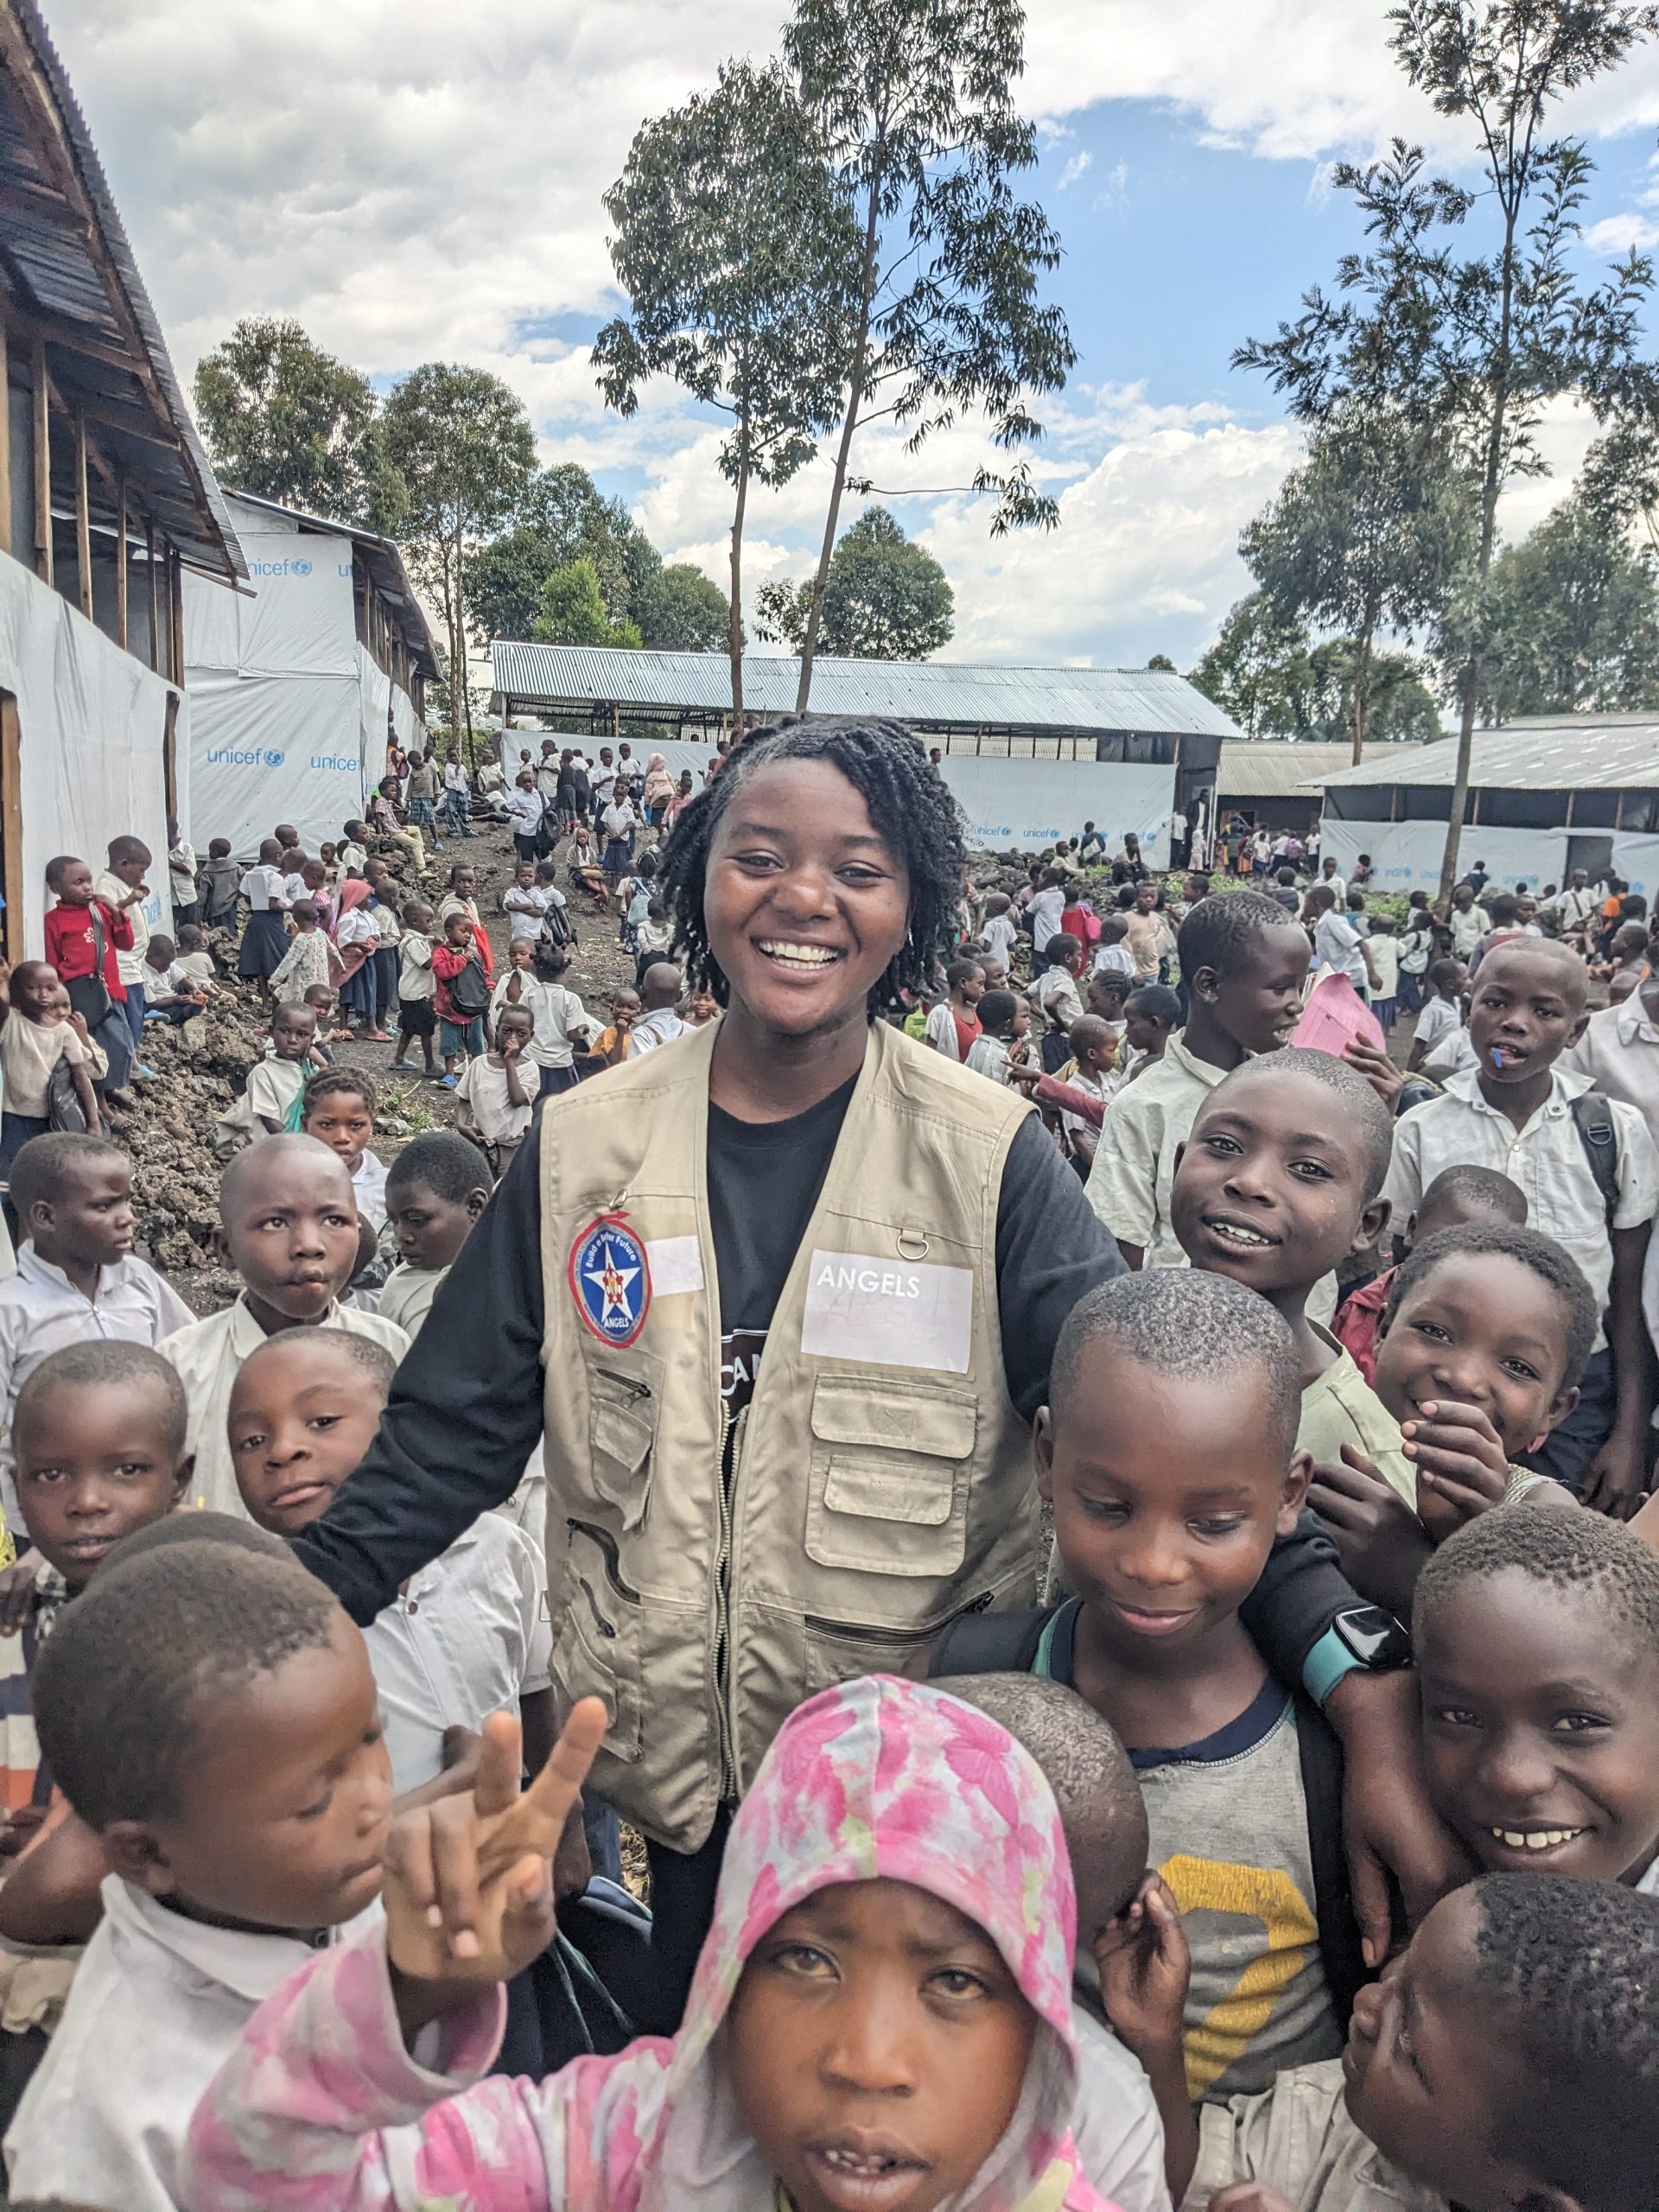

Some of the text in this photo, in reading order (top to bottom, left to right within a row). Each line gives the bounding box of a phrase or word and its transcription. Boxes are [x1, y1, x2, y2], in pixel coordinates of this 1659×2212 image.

[248, 559, 289, 576] nicef
[207, 747, 263, 765] unicef
[974, 827, 1050, 838] unicef unicef
[585, 1245, 598, 1268] Build
[615, 1236, 637, 1262] Future
[816, 1264, 920, 1300] ANGELS
[604, 1317, 629, 1328] ANGELS
